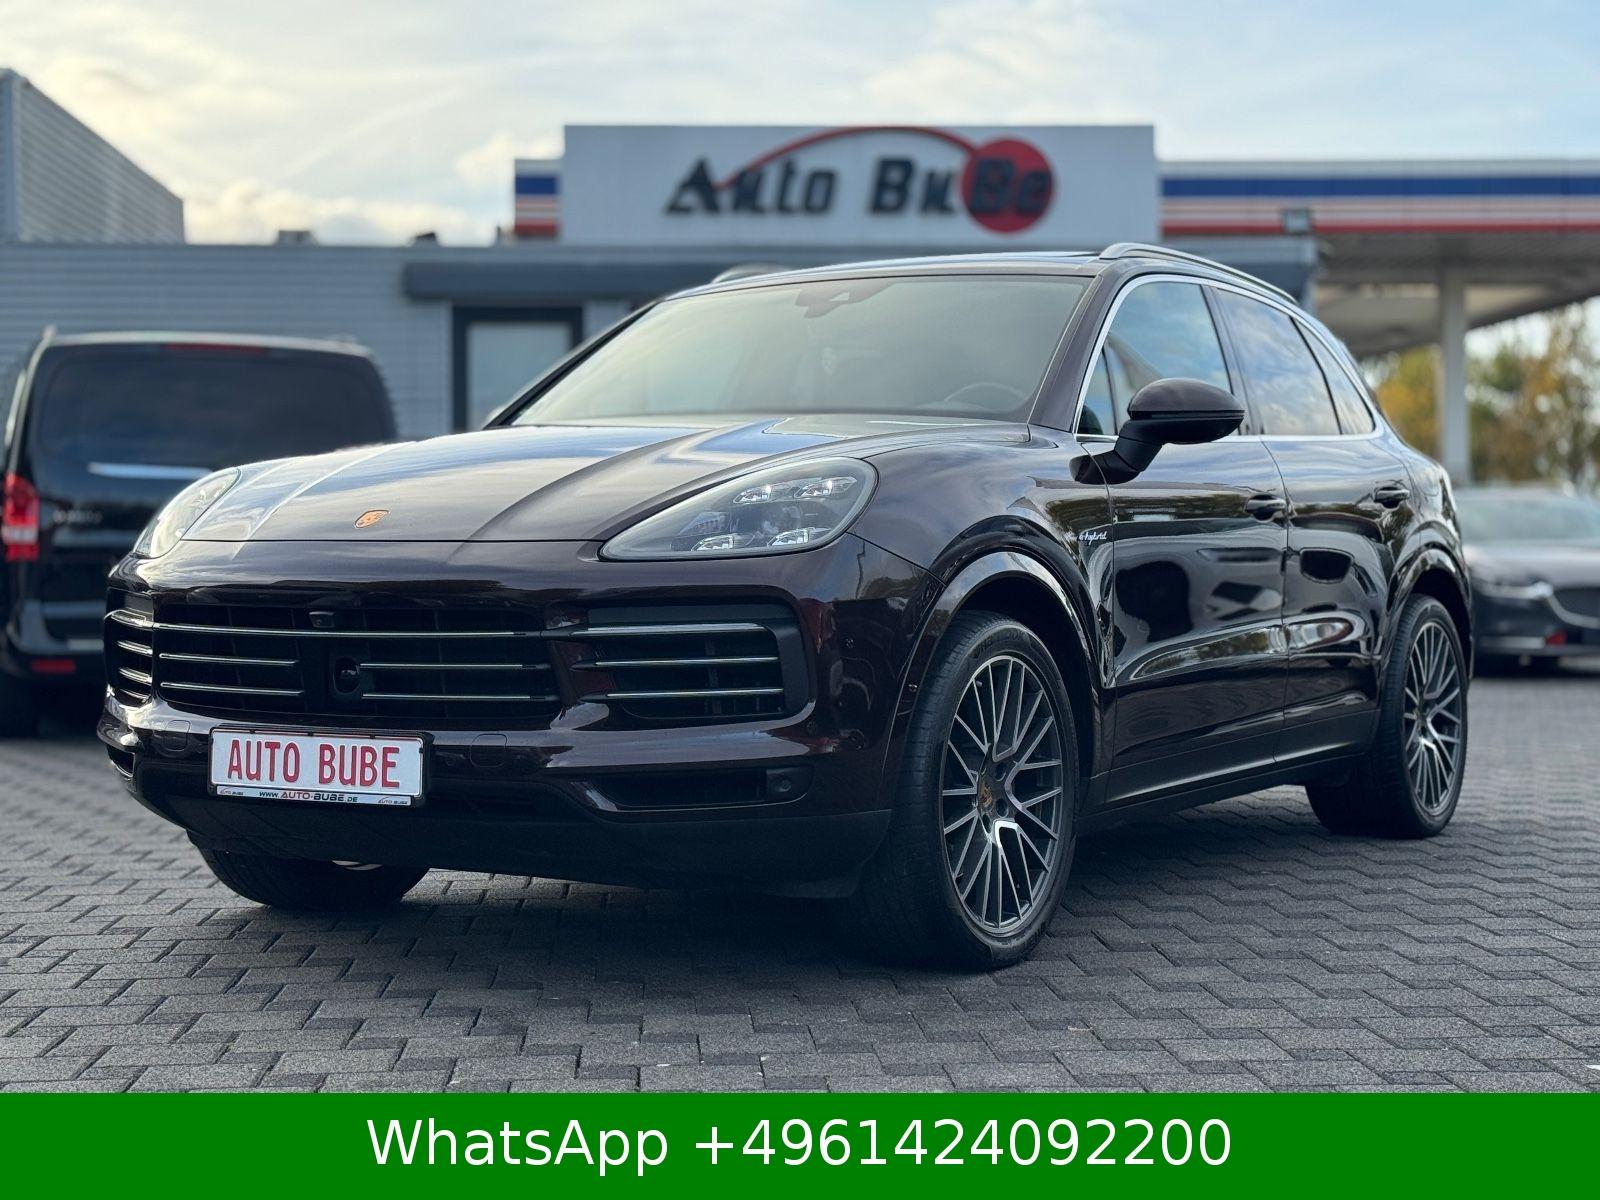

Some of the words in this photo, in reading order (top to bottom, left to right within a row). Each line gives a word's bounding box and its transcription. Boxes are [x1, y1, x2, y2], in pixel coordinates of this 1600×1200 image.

[665, 156, 839, 215] Auto
[227, 739, 300, 783] AUTO
[318, 743, 400, 788] BUBE
